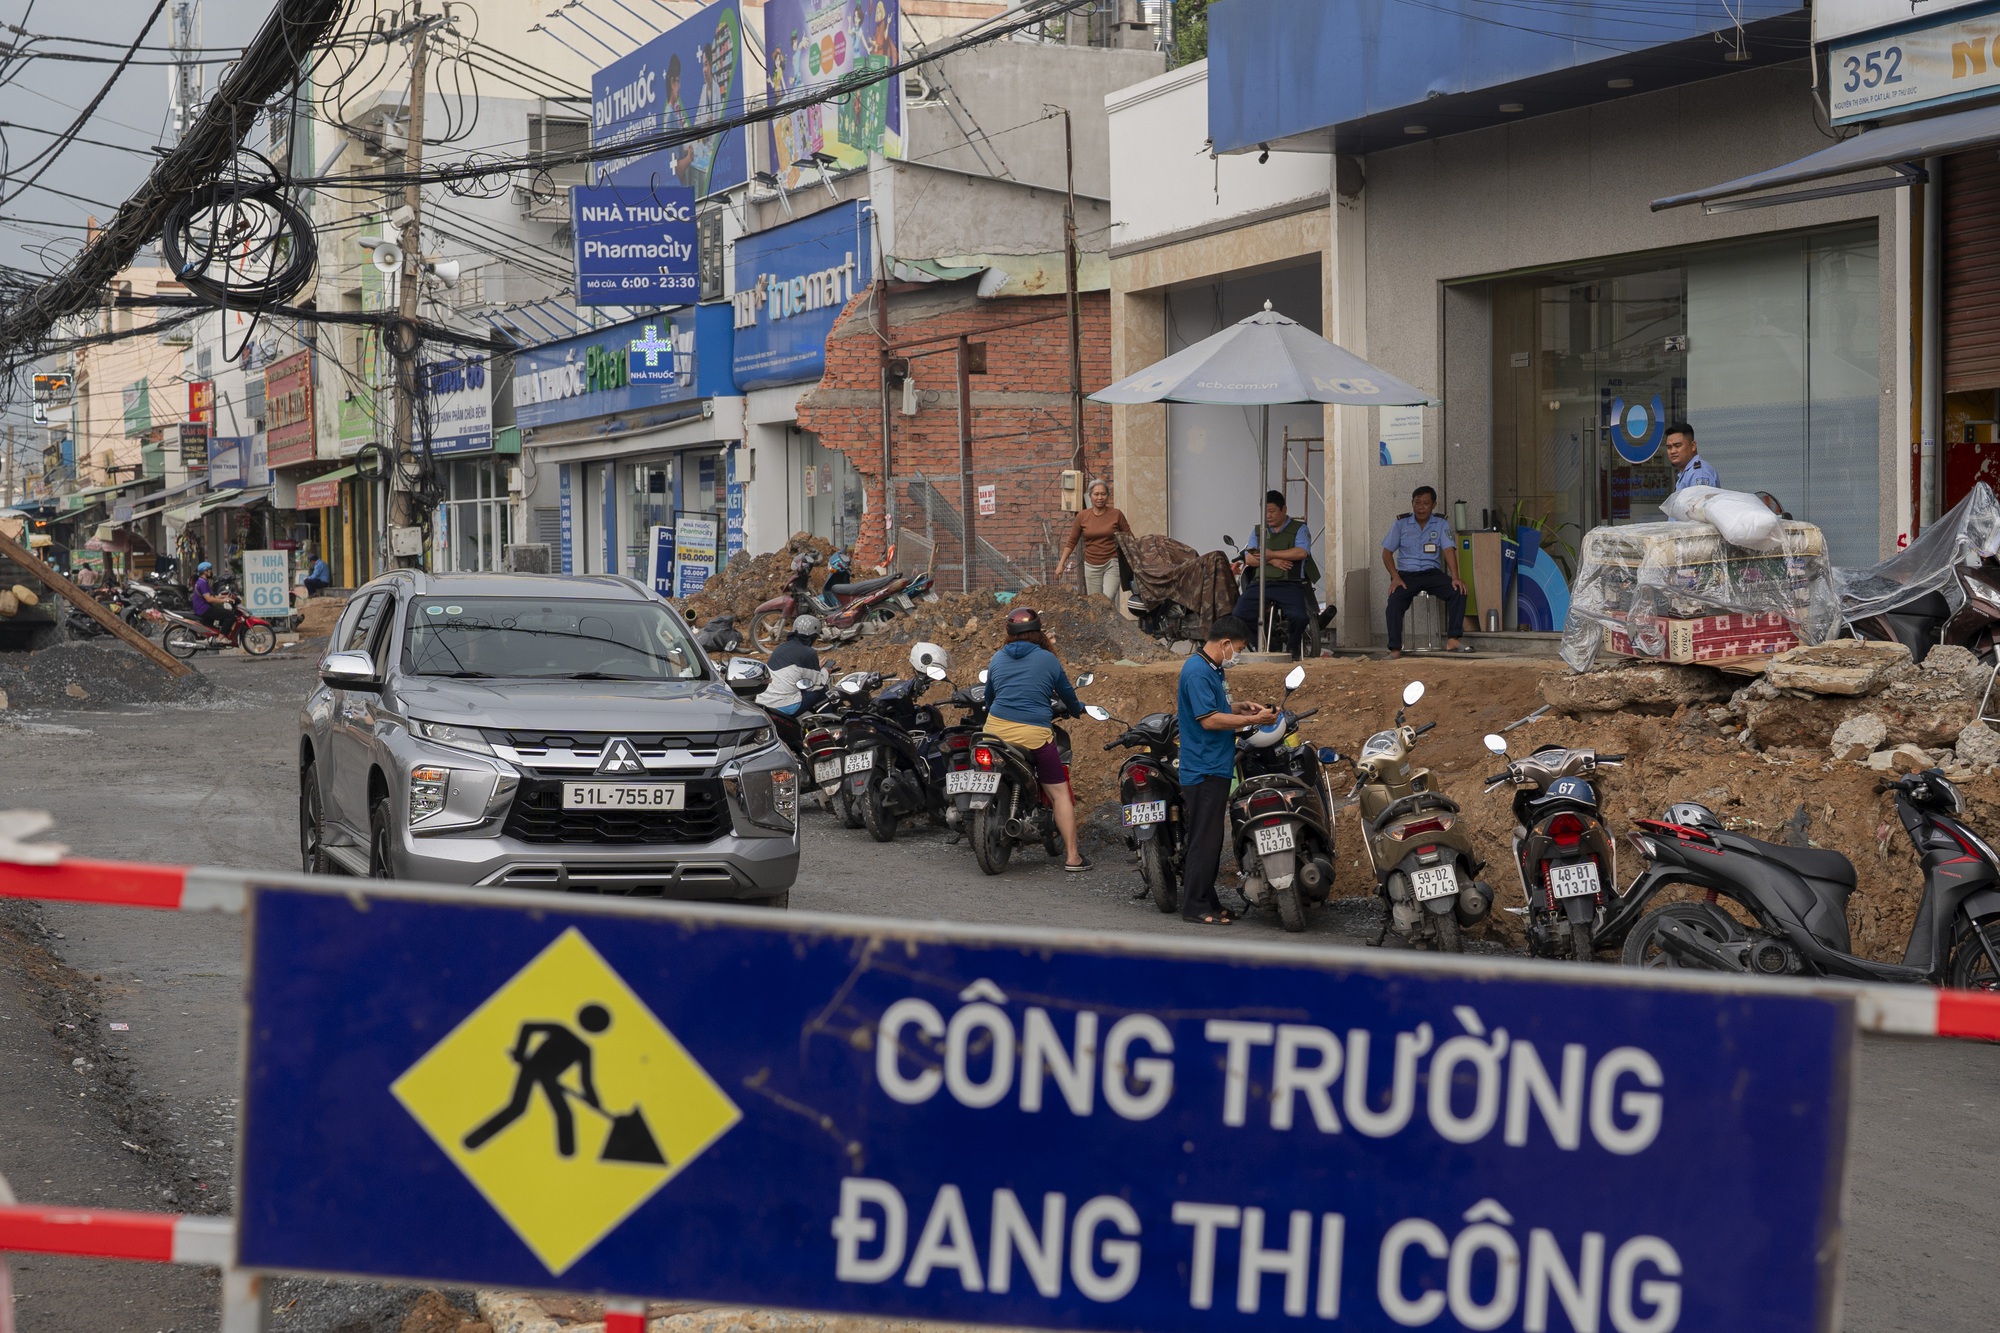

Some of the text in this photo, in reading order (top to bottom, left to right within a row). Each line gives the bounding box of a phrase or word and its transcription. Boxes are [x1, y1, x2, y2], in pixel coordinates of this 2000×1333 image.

[1843, 46, 1902, 93] 352
[595, 64, 656, 131] ĐỦ THUỐC
[582, 201, 691, 222] NHÀ THUỐC
[584, 233, 692, 261] Pharmacity
[601, 280, 617, 288] CỬA
[621, 277, 650, 288] 6:00
[659, 277, 695, 288] 23:30
[731, 290, 757, 329] TH
[512, 362, 541, 408] NHÀ
[538, 348, 586, 401] THUỐC
[630, 369, 674, 379] NHÀ THUỐC
[1196, 379, 1279, 391] acb.com.vn
[1310, 376, 1381, 395] ACB
[728, 488, 741, 509] KẾT
[680, 528, 713, 537] Pharmacity
[262, 553, 284, 567] NHÀ
[678, 553, 715, 562] 150.000Đ
[250, 568, 283, 584] THUỐC
[253, 587, 283, 606] 66
[951, 773, 969, 783] 59-S
[972, 773, 996, 783] 54-X6
[970, 782, 994, 792] 2739
[1558, 782, 1575, 795] 67
[573, 788, 675, 805] 51L-755.87
[1135, 802, 1160, 813] 47-M1
[1132, 811, 1164, 824] 328.55
[1260, 825, 1287, 841] 59-X4
[1260, 837, 1292, 853] 143.78
[1417, 867, 1449, 885] 59-D2
[1558, 865, 1590, 883] 48-B1
[1417, 879, 1456, 899] 247.43
[1556, 879, 1598, 897] 113.76
[875, 977, 1665, 1156] CÔNG TRƯỜNG
[831, 1176, 1683, 1333] ĐANG THI CÔNG
